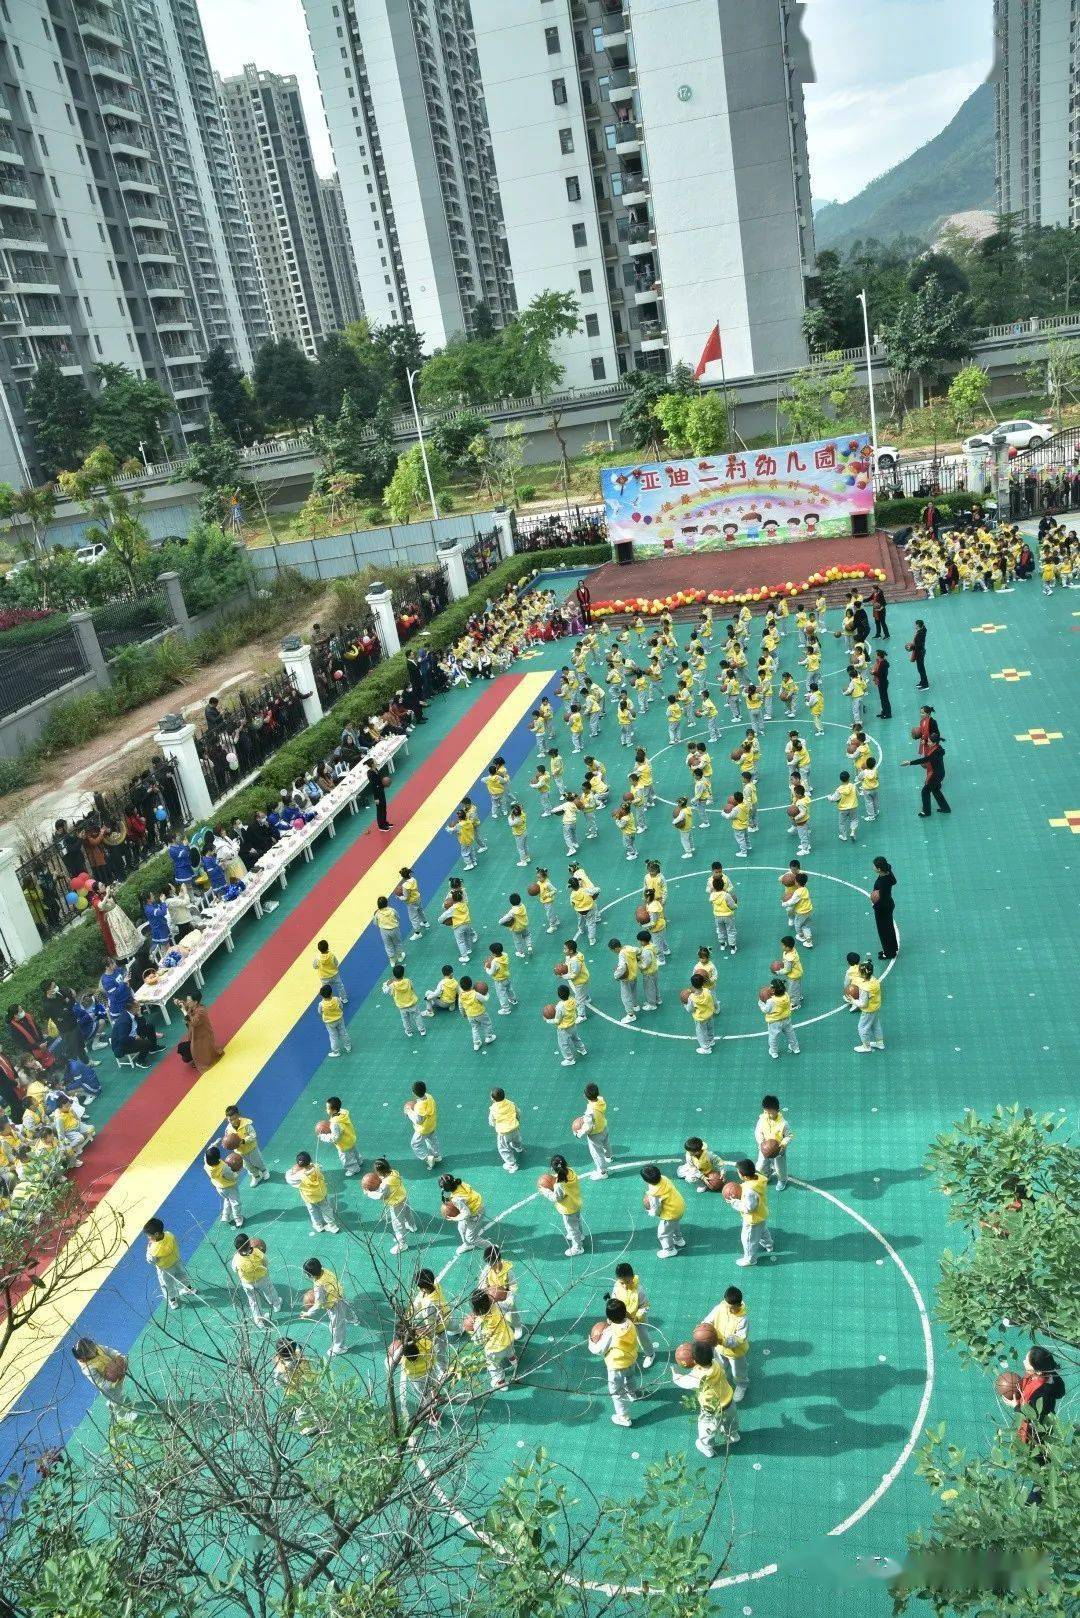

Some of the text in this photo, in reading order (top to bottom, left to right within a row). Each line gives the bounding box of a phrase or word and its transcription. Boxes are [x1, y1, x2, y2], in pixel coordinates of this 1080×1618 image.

[640, 448, 836, 491] 亚迪二村幼儿园
